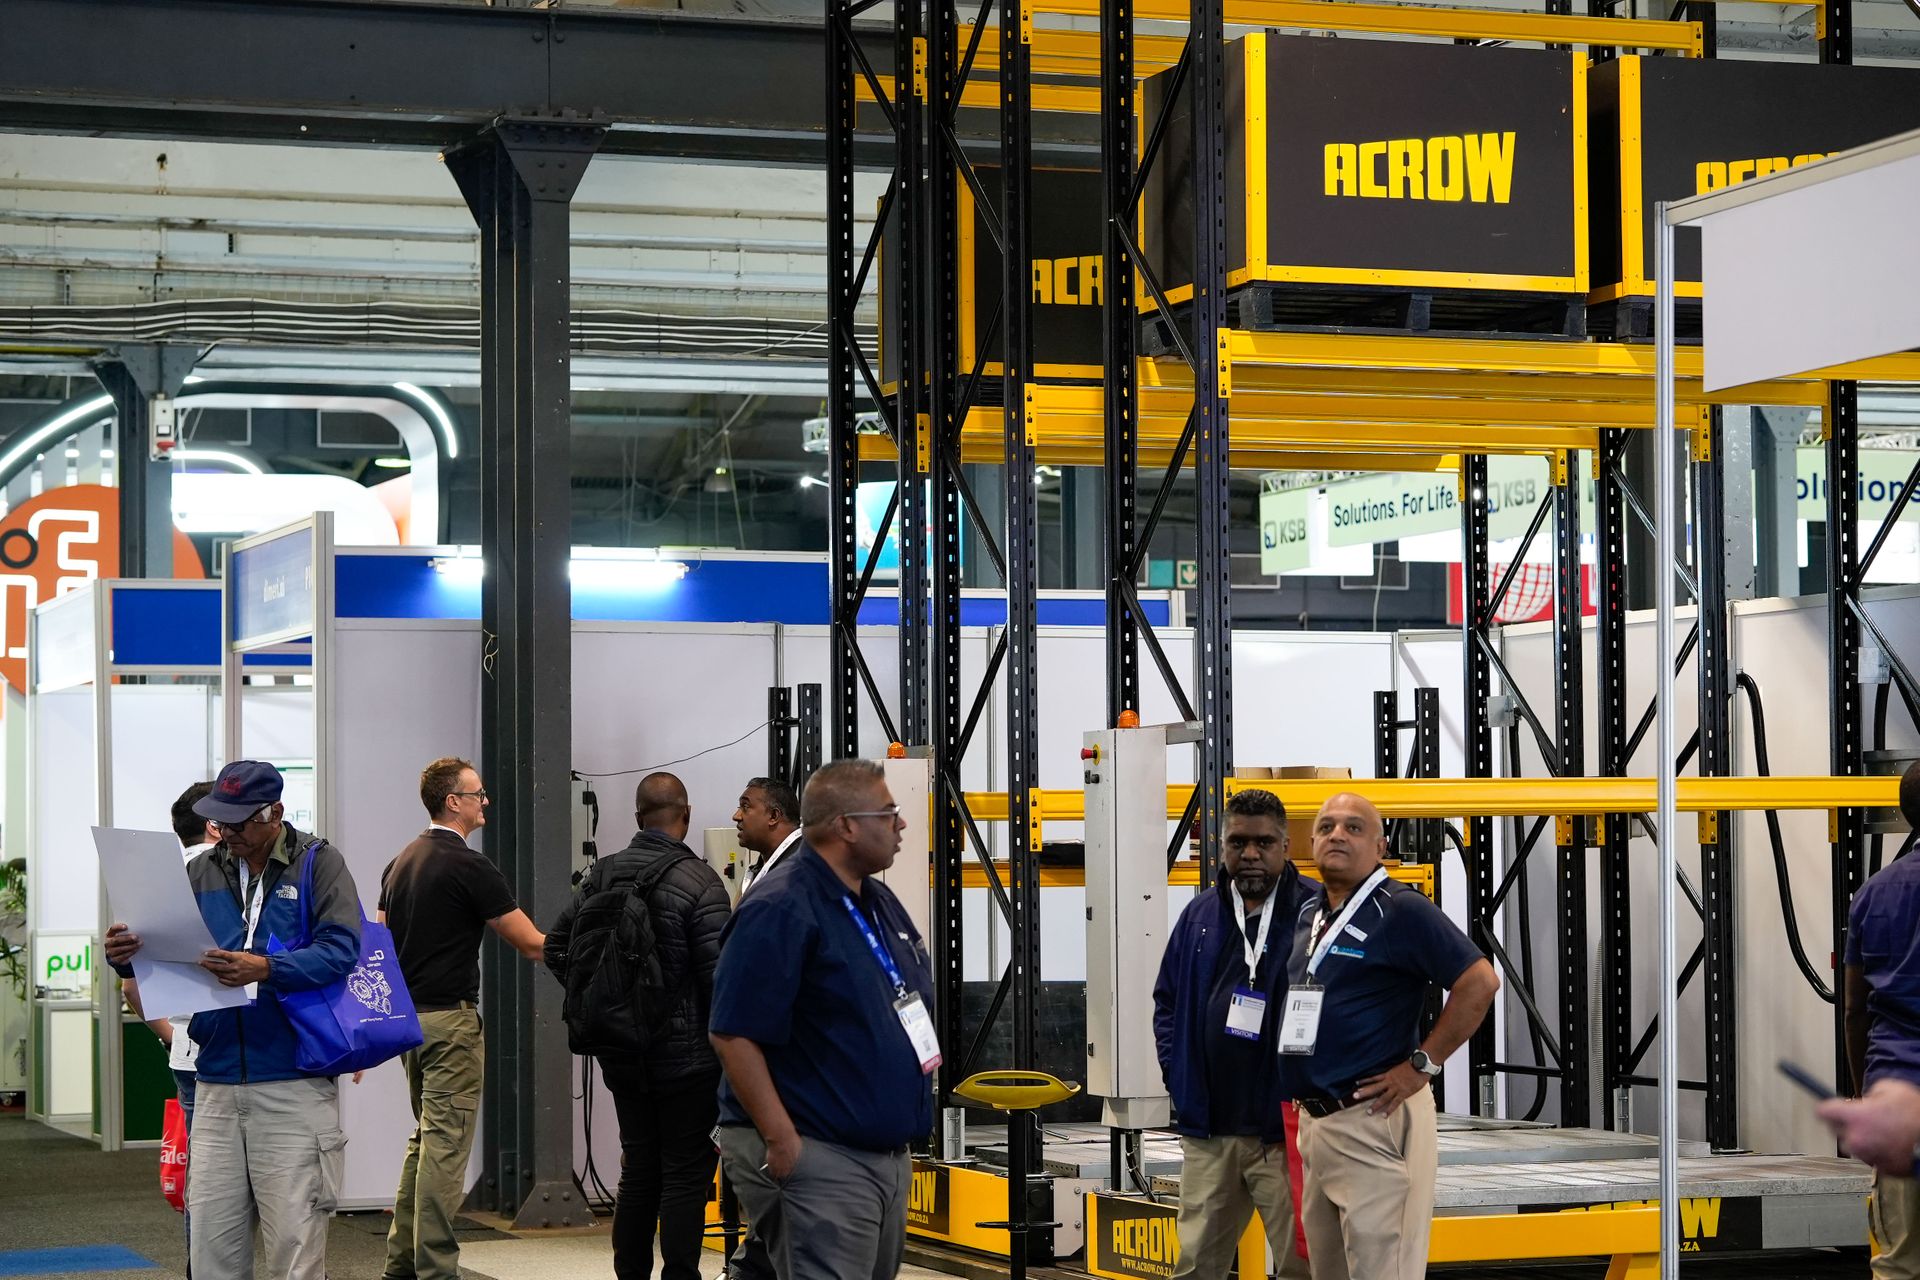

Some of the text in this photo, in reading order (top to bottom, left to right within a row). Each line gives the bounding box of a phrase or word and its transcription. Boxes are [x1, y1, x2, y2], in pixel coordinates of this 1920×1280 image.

[1324, 132, 1516, 203] ACROW
[1334, 486, 1457, 527] Solutions. For Life.
[1504, 479, 1536, 508] KSB
[1280, 518, 1306, 543] KSB
[1231, 1028, 1253, 1039] VISITOR
[1113, 1217, 1181, 1265] ACROW
